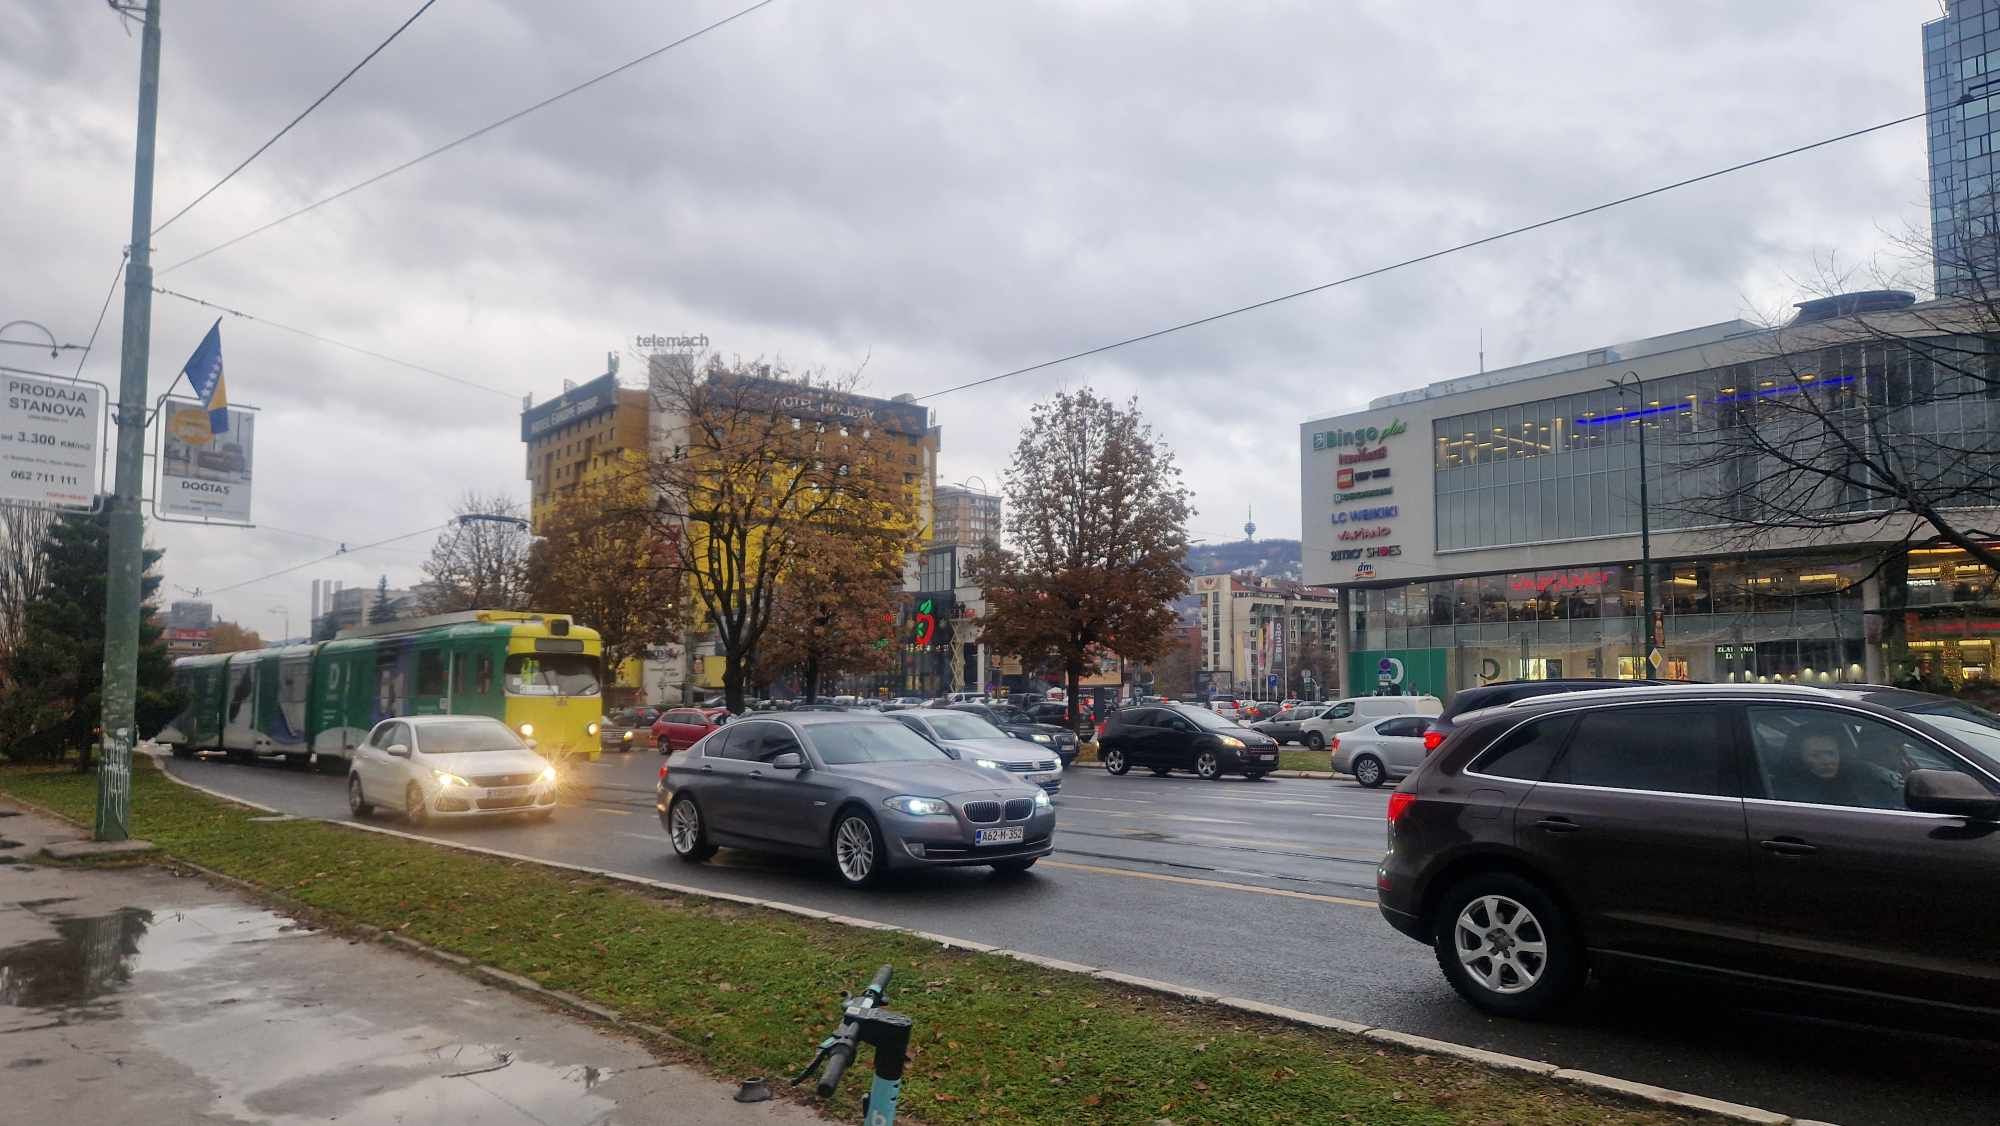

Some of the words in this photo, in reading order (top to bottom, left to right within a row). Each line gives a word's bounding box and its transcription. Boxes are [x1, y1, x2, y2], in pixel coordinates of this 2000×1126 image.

[636, 333, 709, 348] telemach
[9, 381, 88, 403] PRODAJA
[9, 397, 86, 418] STANOVA
[1326, 427, 1378, 448] Bingo
[10, 470, 33, 480] 062
[35, 472, 56, 483] 711
[60, 475, 78, 485] 111
[1331, 512, 1347, 525] LC
[1366, 545, 1402, 558] SHOES
[1357, 561, 1373, 572] dm
